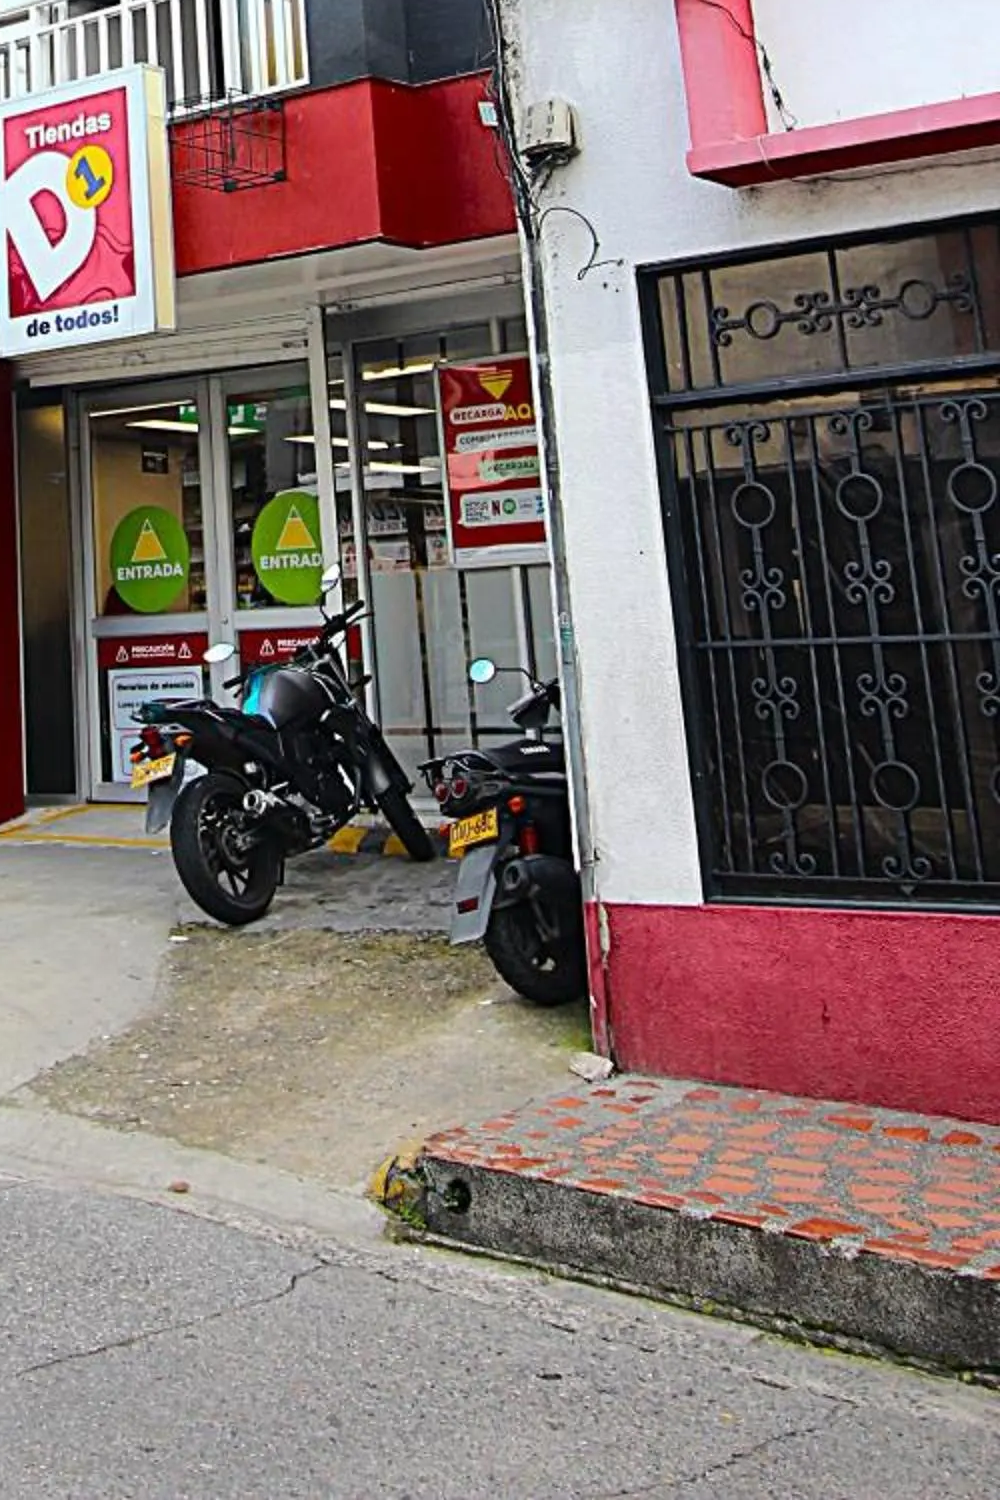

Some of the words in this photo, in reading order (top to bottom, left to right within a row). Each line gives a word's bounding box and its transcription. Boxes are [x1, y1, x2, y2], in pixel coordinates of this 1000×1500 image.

[24, 111, 111, 149] Tiendas
[26, 319, 51, 338] de
[55, 304, 119, 332] todos!
[453, 408, 503, 421] RECARGA
[504, 403, 537, 421] AQ
[260, 553, 322, 570] ENTRAD
[117, 562, 184, 582] ENTRADA
